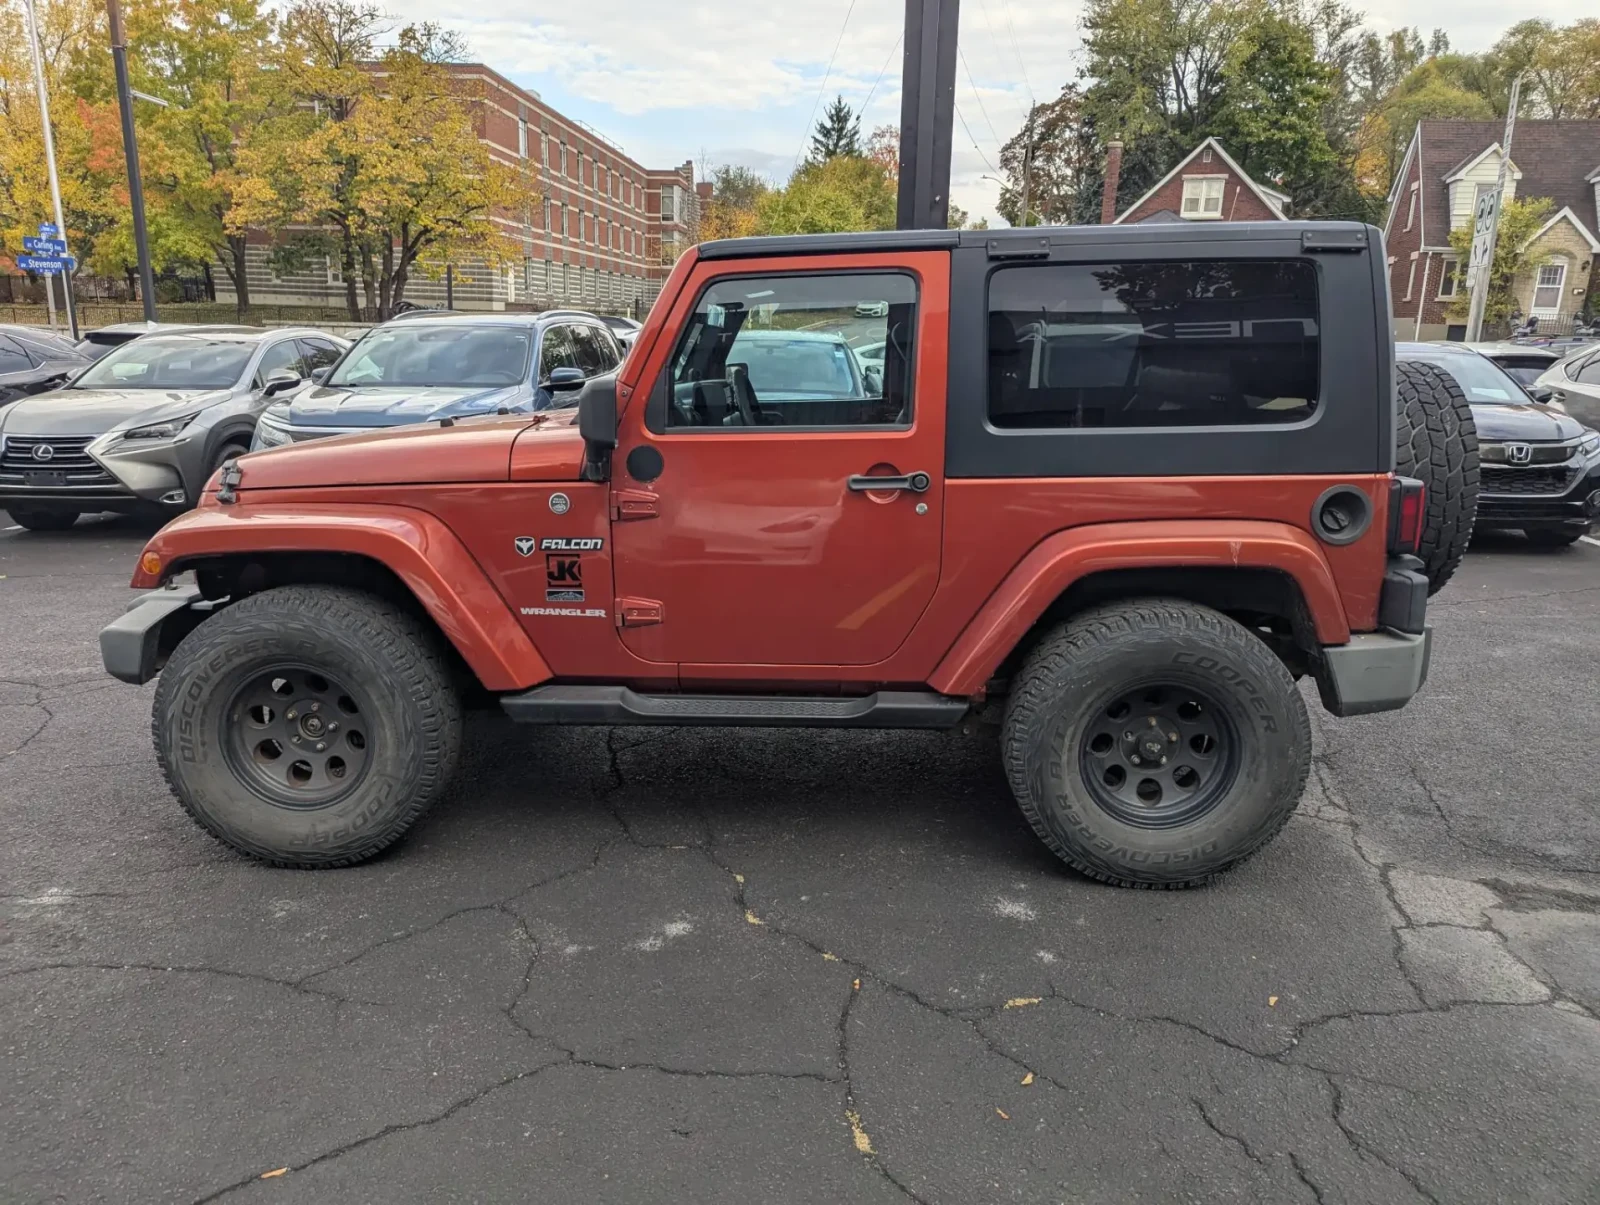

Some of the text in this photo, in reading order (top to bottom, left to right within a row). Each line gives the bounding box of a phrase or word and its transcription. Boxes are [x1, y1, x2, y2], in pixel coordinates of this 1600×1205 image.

[33, 240, 54, 252] Carling
[28, 259, 62, 269] Stevenson
[541, 538, 603, 550] FALCON
[548, 560, 581, 581] JK
[520, 607, 607, 618] WRANGLER
[178, 638, 282, 763] DISCOVERER
[1171, 651, 1279, 735] COOPER
[290, 780, 394, 848] COOPER
[1057, 793, 1220, 866] DISCOVERER
